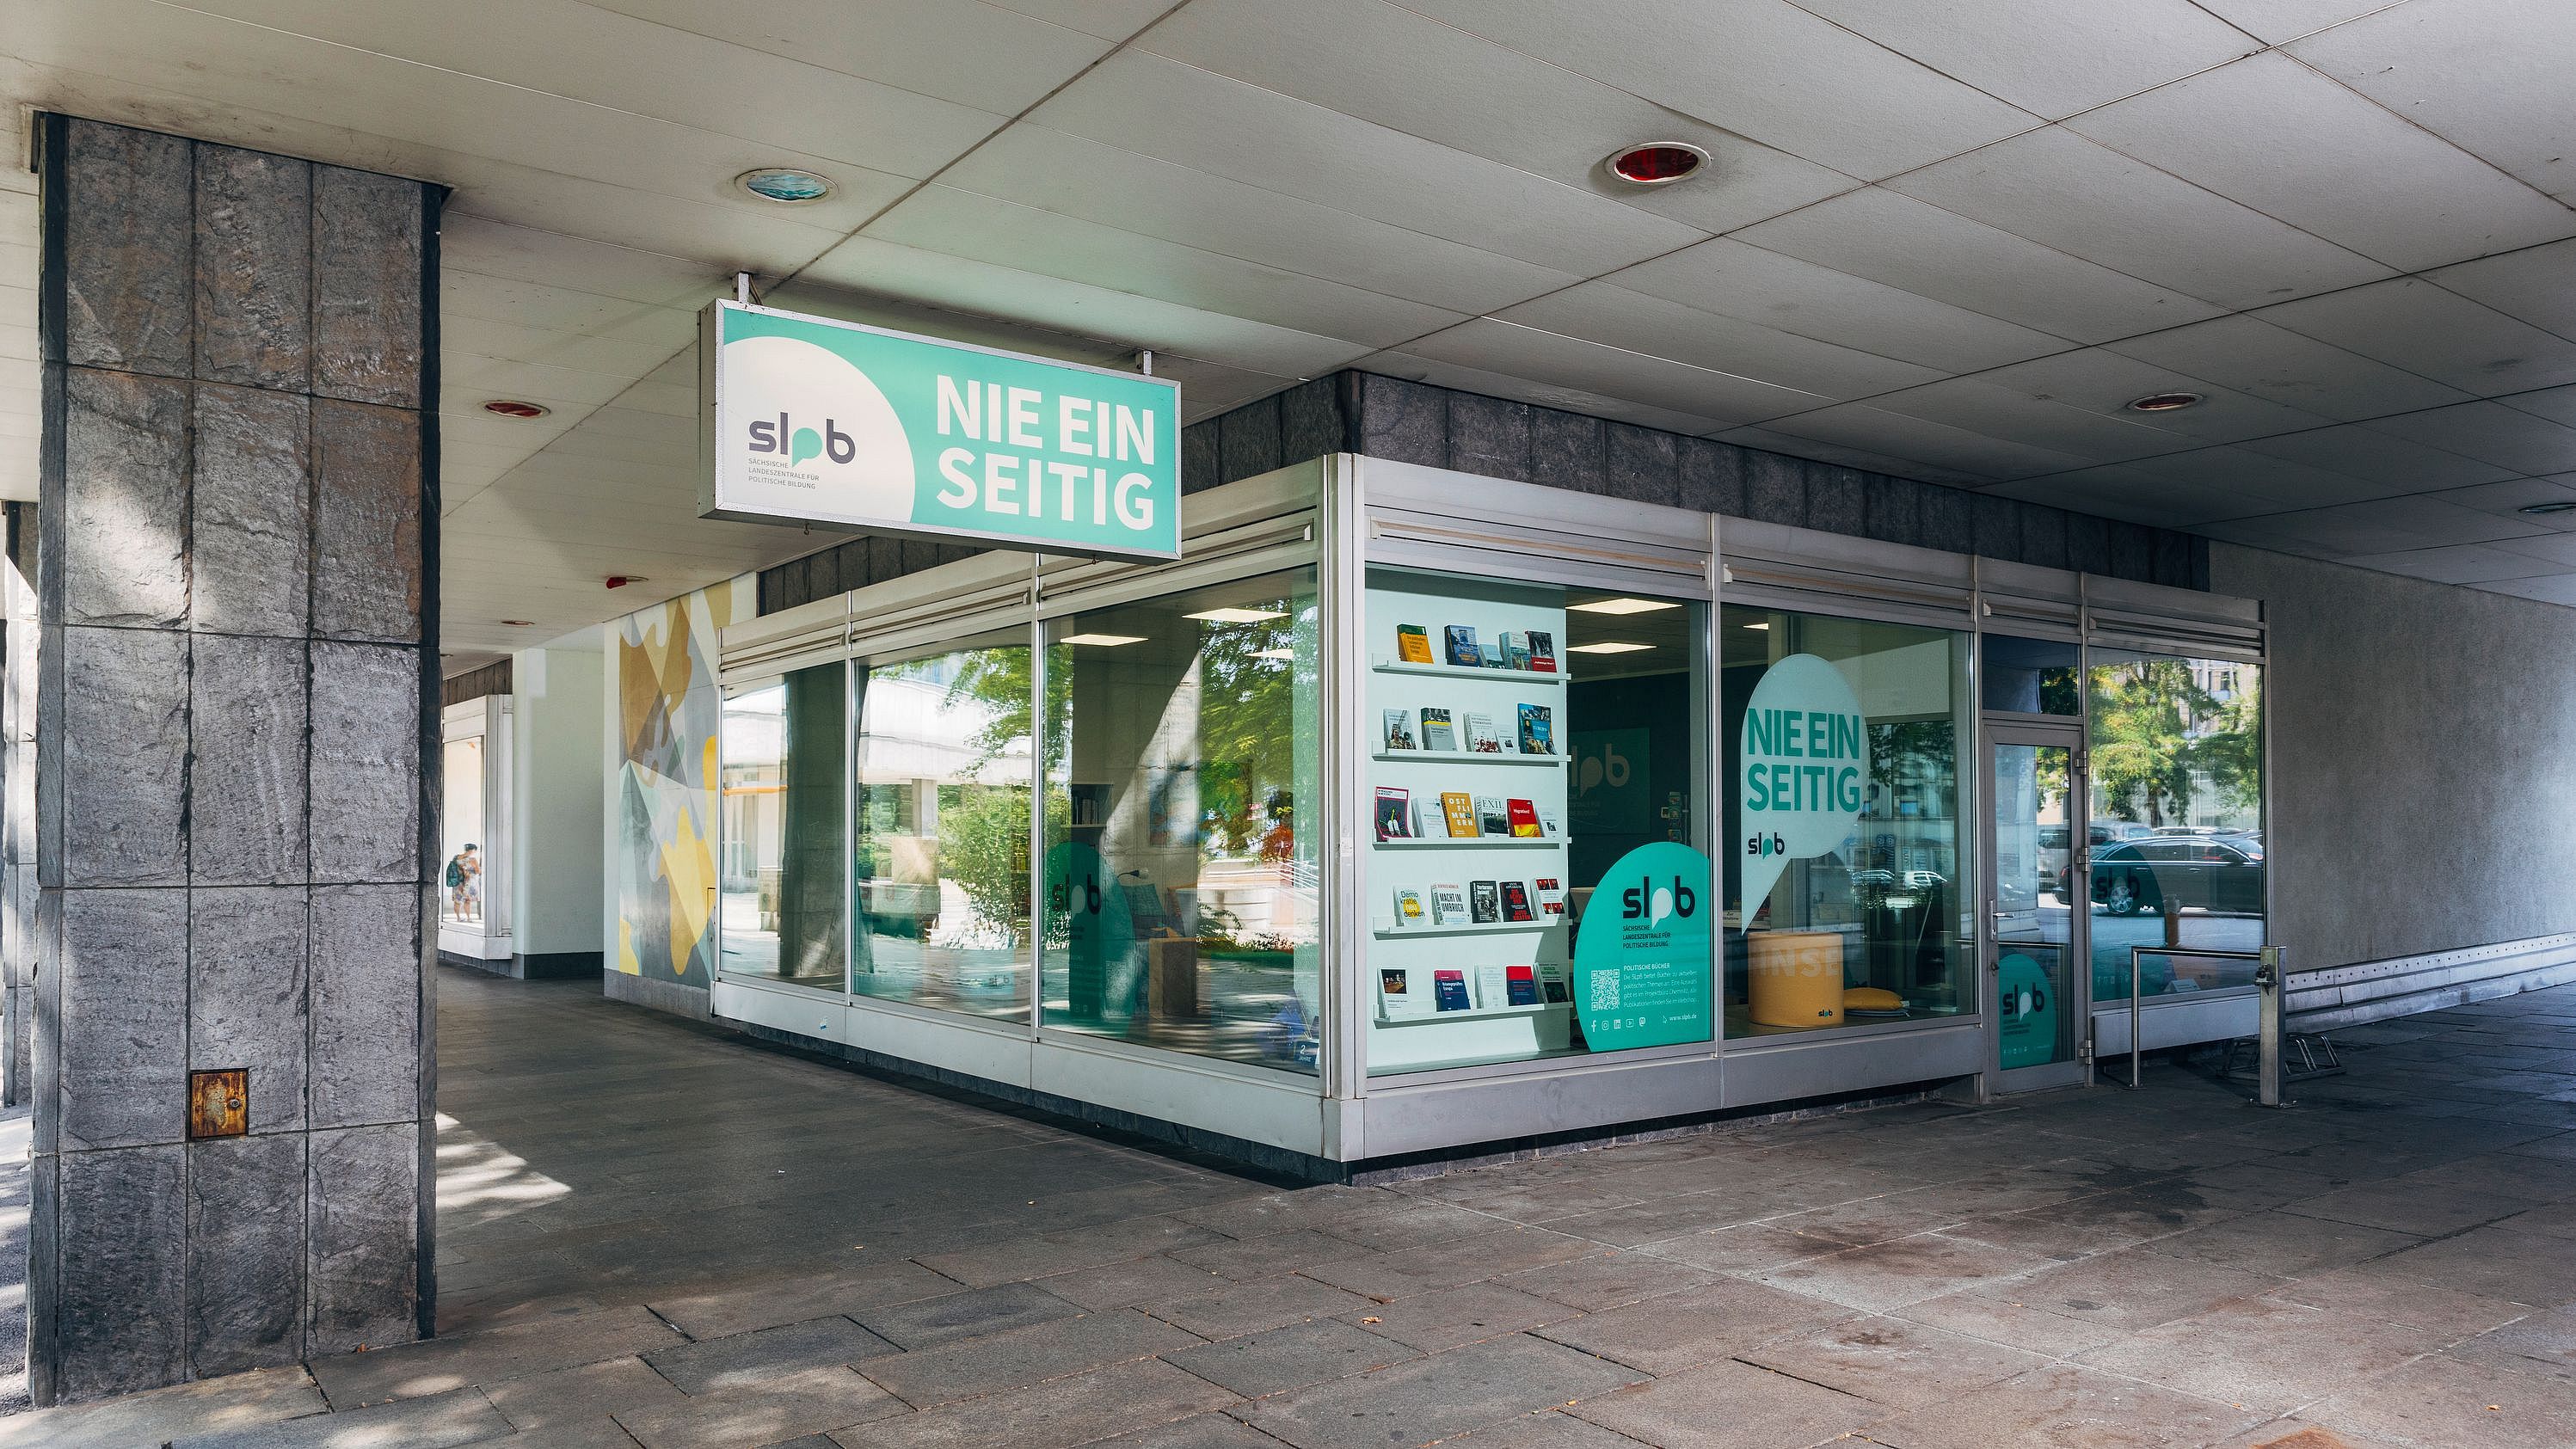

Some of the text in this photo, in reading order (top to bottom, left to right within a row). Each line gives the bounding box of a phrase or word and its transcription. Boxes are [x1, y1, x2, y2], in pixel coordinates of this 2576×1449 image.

[937, 374, 1154, 465] NIE EIN
[748, 457, 789, 469] SÄCHSISCHE
[748, 467, 806, 480] LANDESZENTRALE
[748, 476, 816, 489] POLITISCHE BILDUNG
[936, 447, 1154, 531] SEITIG
[1748, 708, 1860, 759] NIE EIN
[1747, 763, 1860, 813] SEITIG
[1482, 799, 1505, 809] EXIL
[1439, 893, 1455, 902] MACHT
[1441, 903, 1465, 912] UMBRUCH
[1622, 930, 1671, 941] LANDESZENTRALE FÜR
[1300, 1044, 1306, 1055] 2
